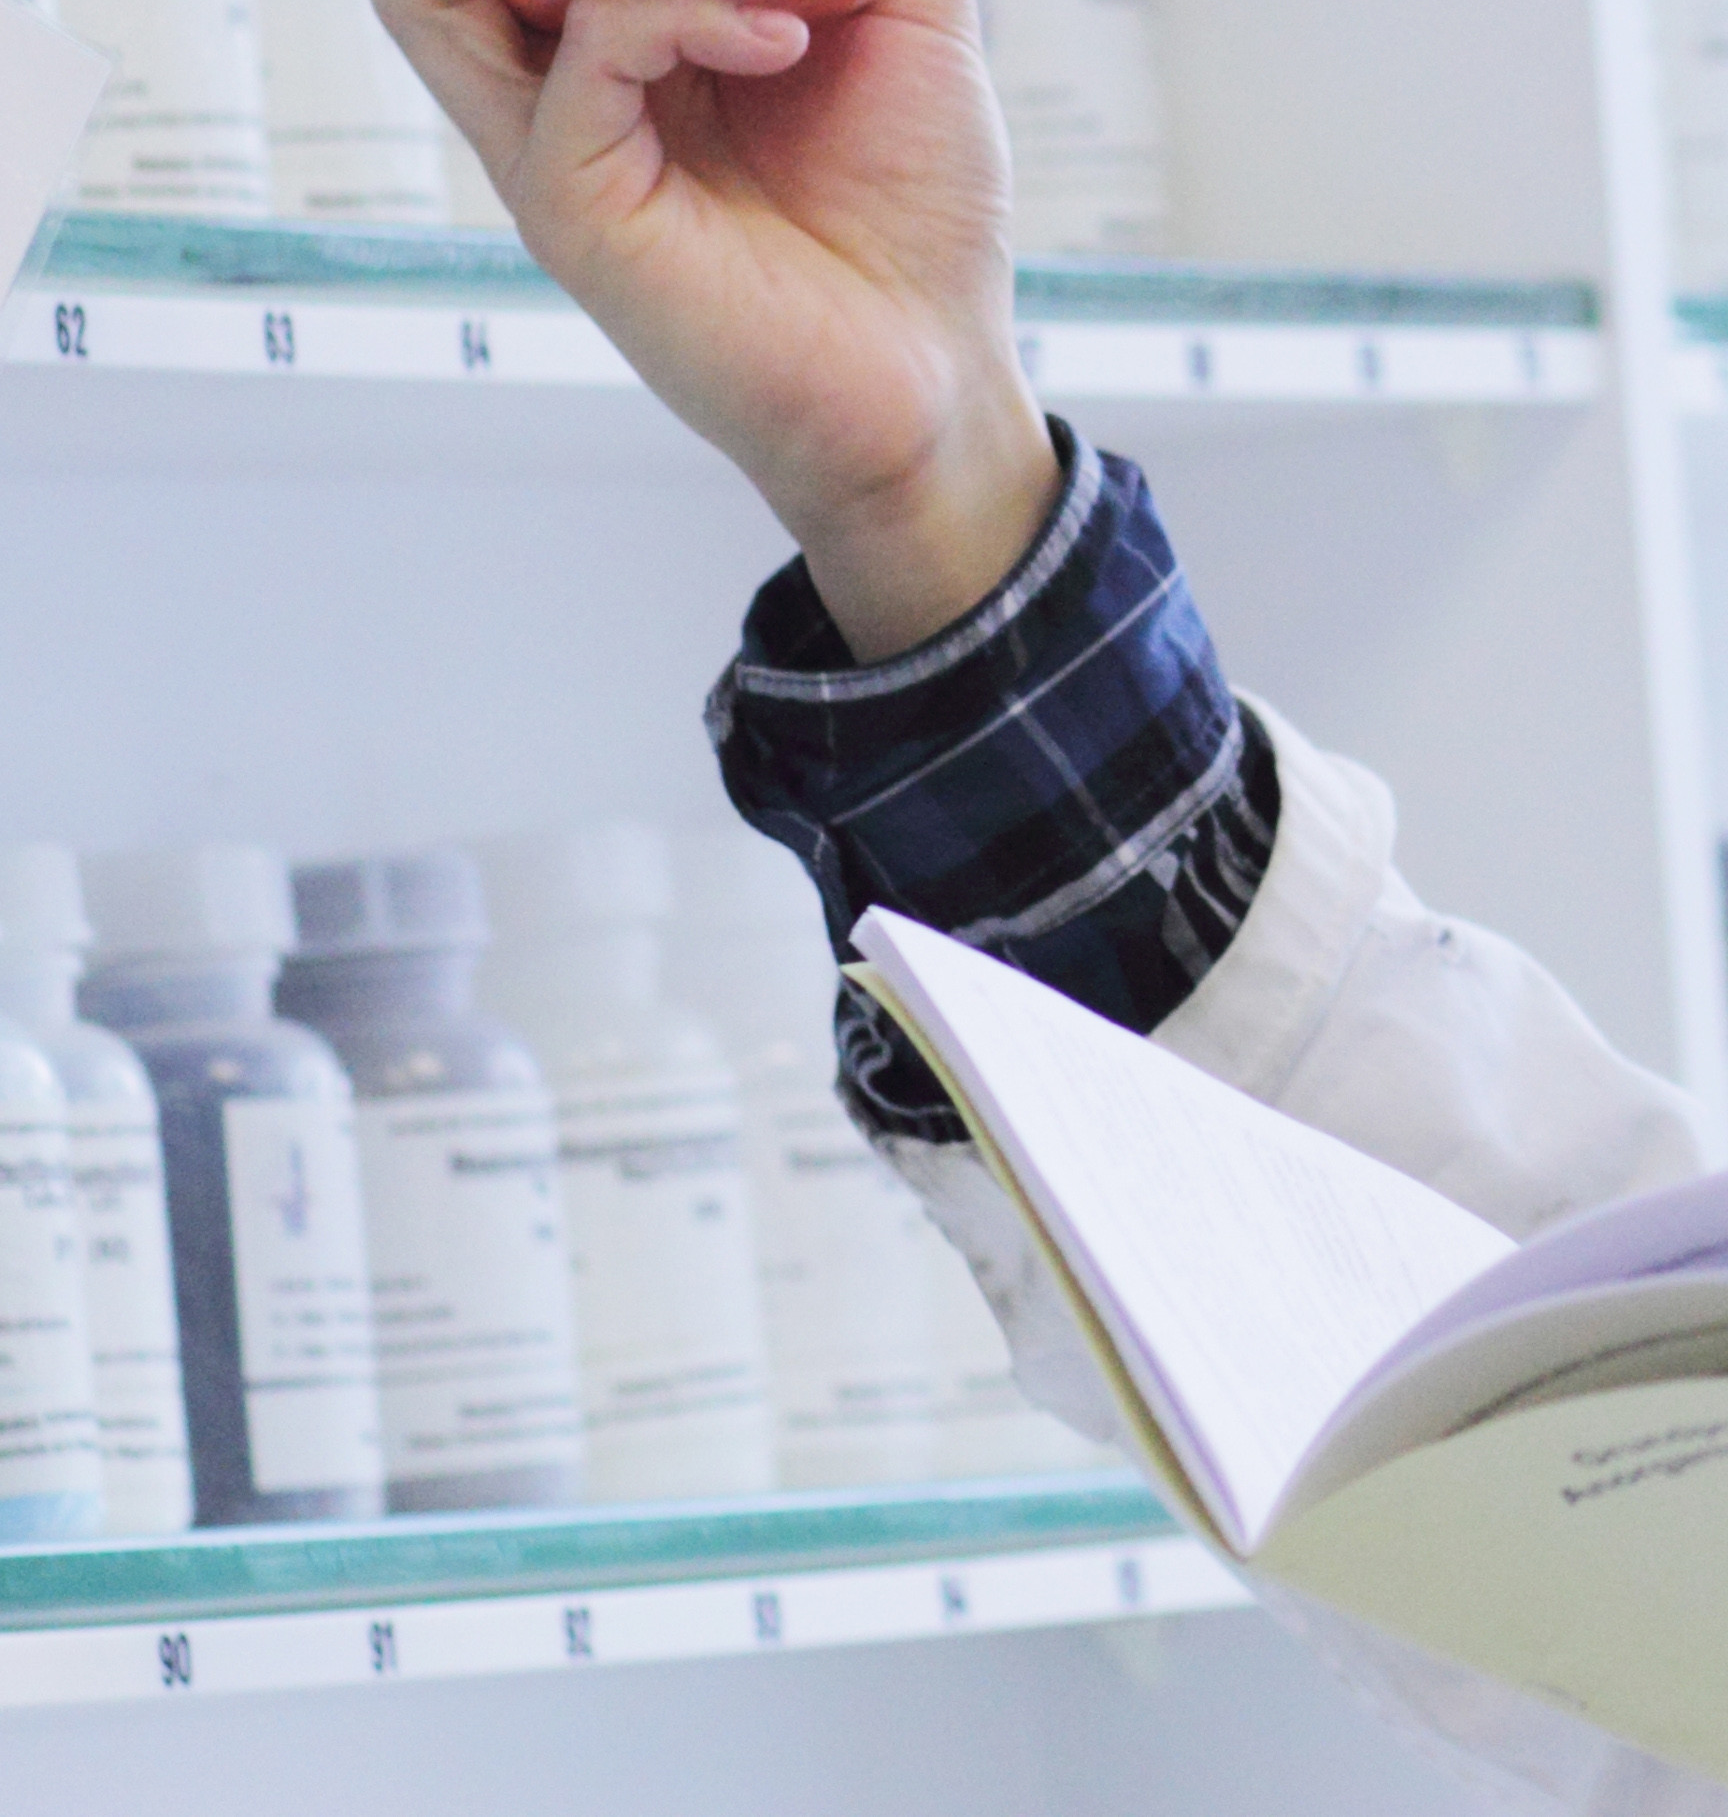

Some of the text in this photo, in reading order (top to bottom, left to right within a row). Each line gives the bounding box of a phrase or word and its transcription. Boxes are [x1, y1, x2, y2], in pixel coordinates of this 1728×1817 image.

[54, 303, 88, 358] 62
[262, 311, 294, 364] 63
[158, 1634, 193, 1687] 90
[370, 1621, 397, 1672] 91
